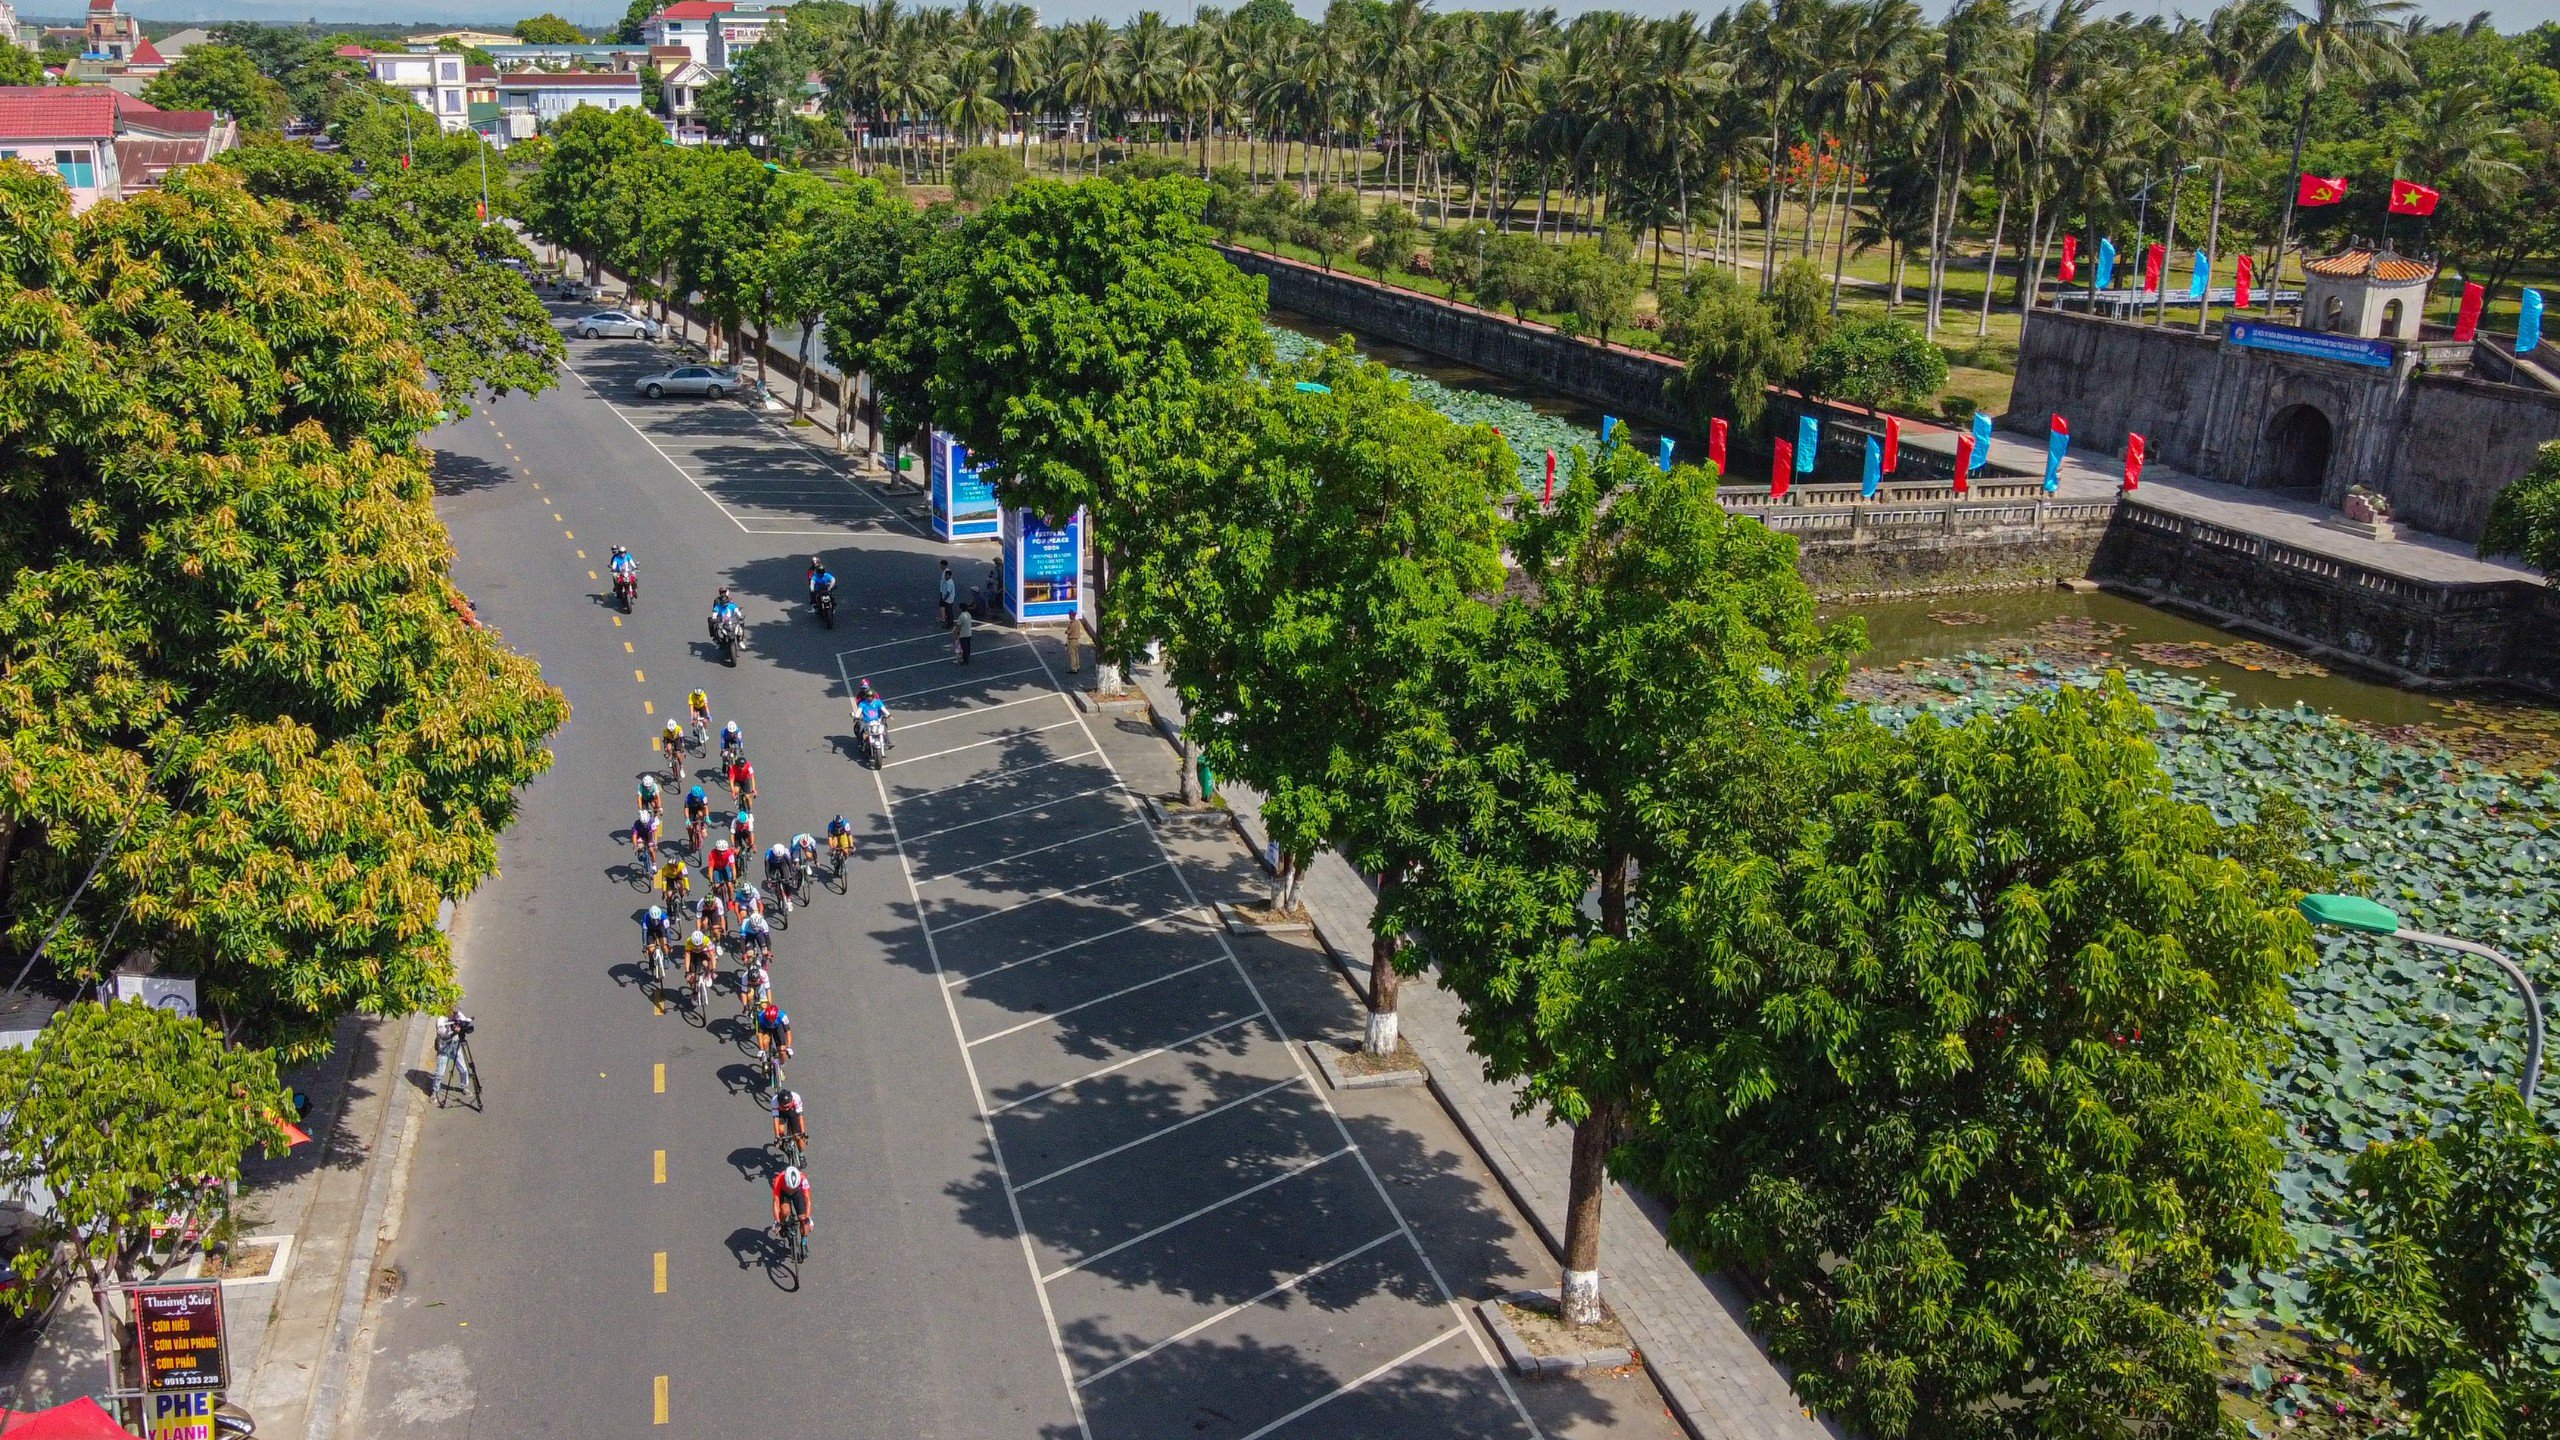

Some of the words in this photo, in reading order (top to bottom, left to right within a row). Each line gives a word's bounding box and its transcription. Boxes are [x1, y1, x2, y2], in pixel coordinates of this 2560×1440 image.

[152, 1319, 171, 1333] CƠM
[154, 1338, 173, 1351] CƠM
[156, 1357, 174, 1369] CƠM
[186, 1376, 202, 1385] 333
